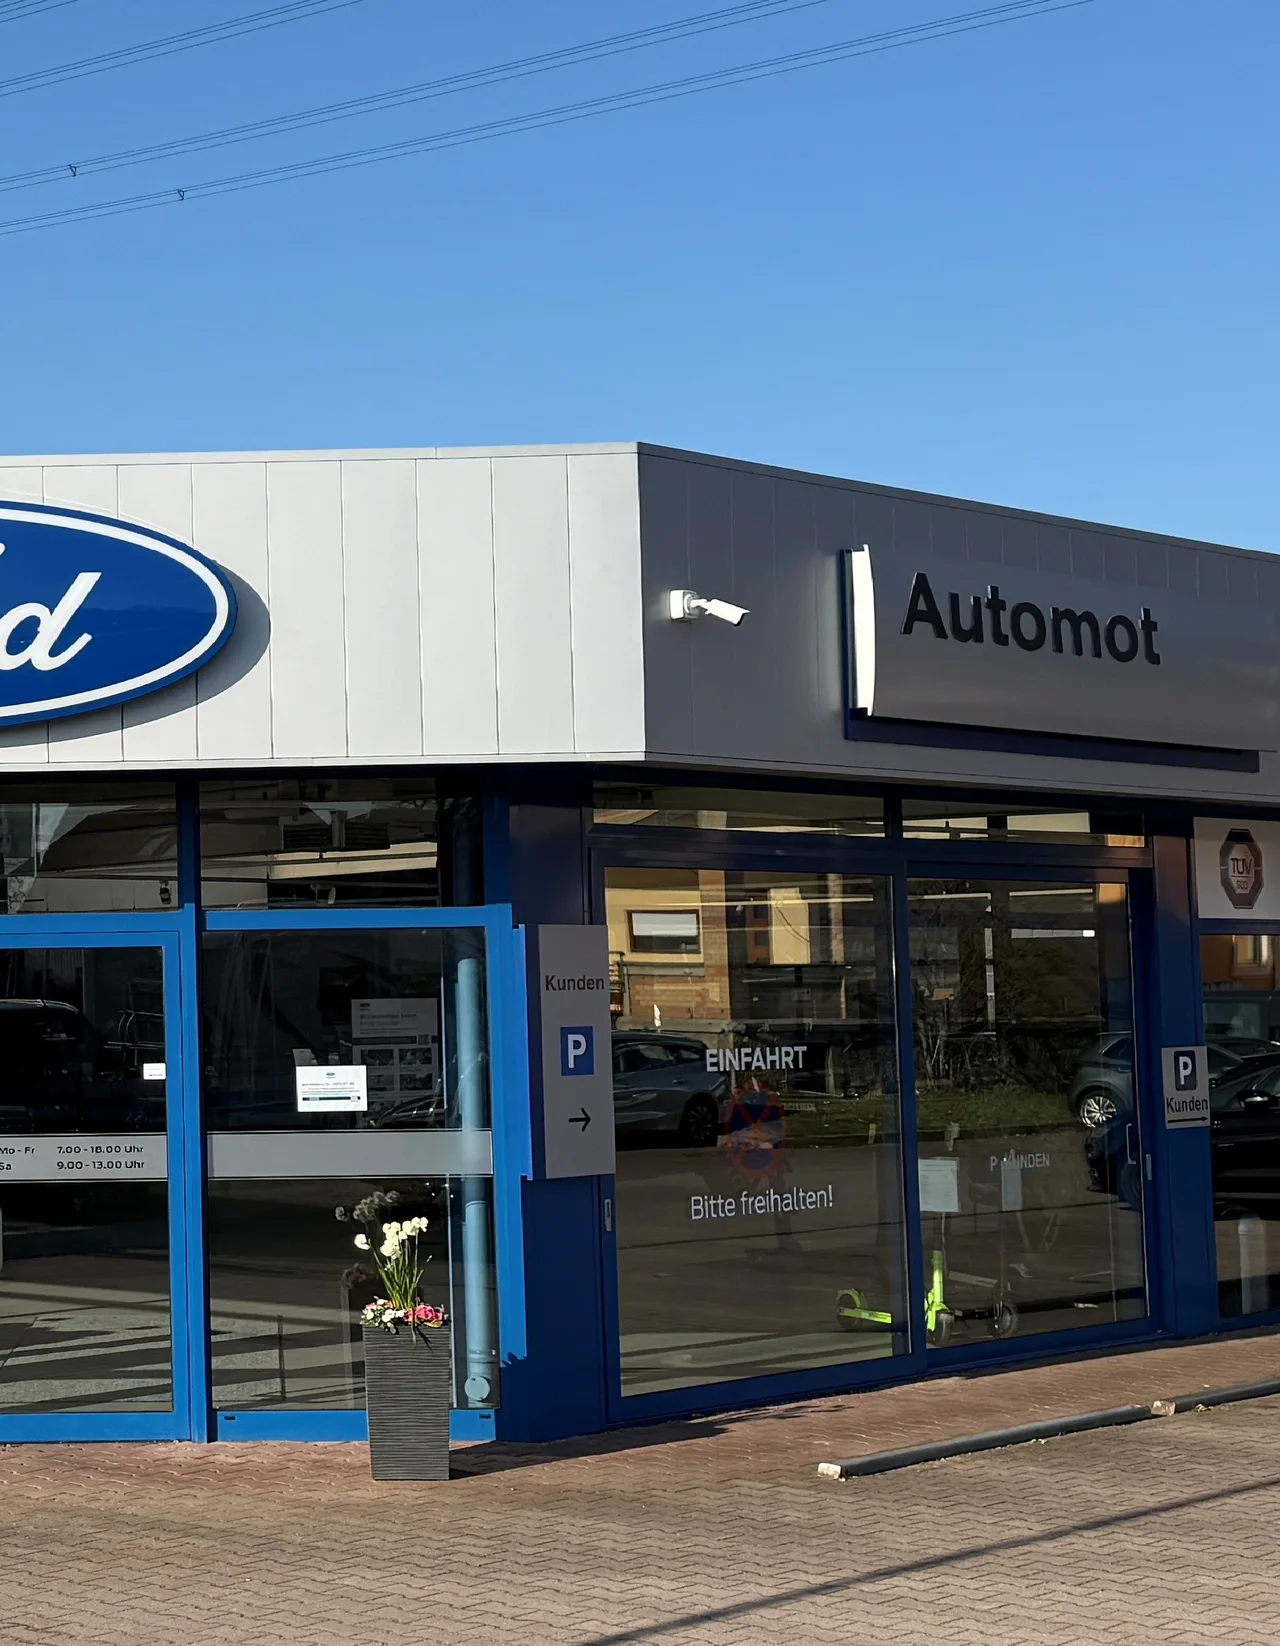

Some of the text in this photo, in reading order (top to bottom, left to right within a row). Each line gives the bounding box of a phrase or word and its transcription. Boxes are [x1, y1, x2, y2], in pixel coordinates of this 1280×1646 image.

[900, 572, 1161, 665] Automot
[545, 975, 605, 991] Kunden
[567, 1034, 587, 1069] P
[705, 1046, 807, 1072] EINFAHRT
[1179, 1056, 1193, 1085] P
[1166, 1096, 1209, 1113] Kunden
[24, 1146, 35, 1155] Fr
[57, 1146, 82, 1154] 7.00
[90, 1145, 121, 1154] 18.00
[124, 1145, 144, 1153] Uhr
[57, 1161, 83, 1170] 9.00
[92, 1160, 122, 1169] 13.00
[125, 1160, 145, 1169] Uhr
[691, 1184, 833, 1220] Bitte freihalten!
